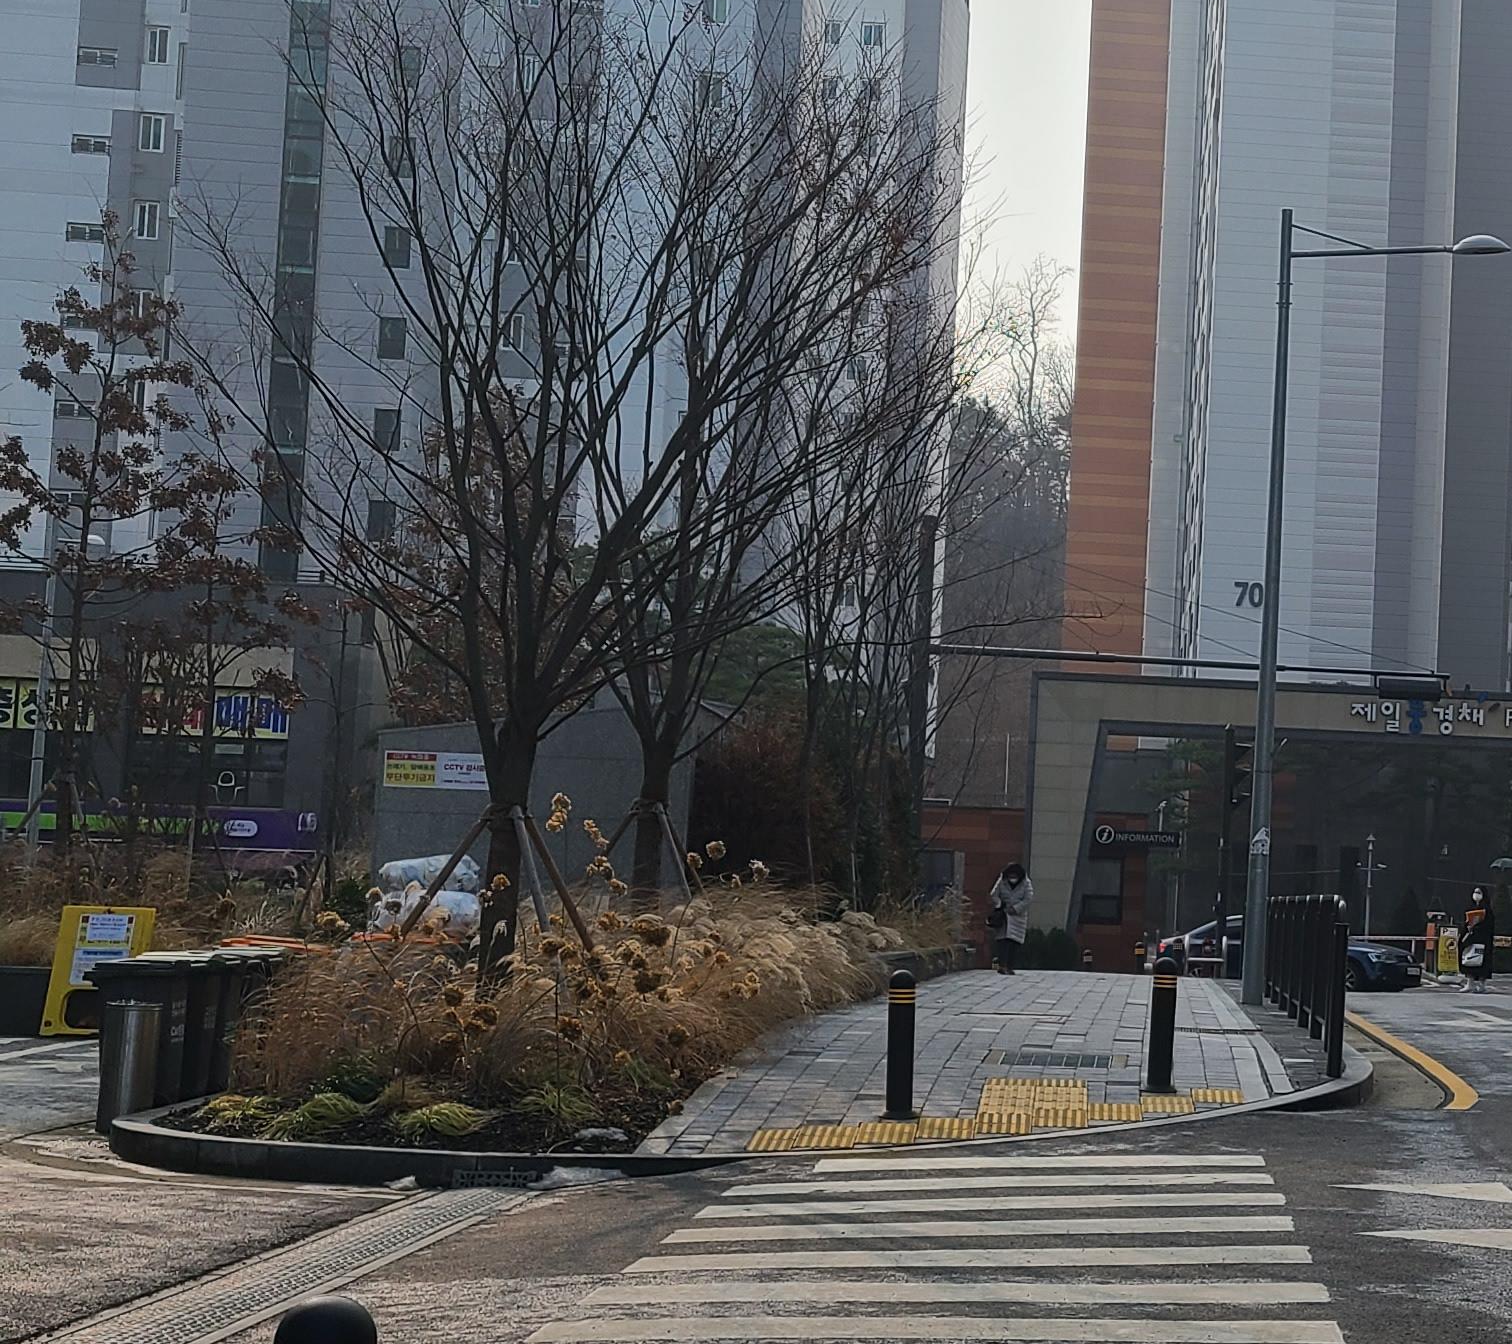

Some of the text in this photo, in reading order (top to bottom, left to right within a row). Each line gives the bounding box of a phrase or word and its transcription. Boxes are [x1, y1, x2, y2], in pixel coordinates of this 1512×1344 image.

[1234, 581, 1264, 608] 70
[1351, 698, 1485, 735] 제일풍경채
[444, 763, 464, 771] CCTV
[1116, 833, 1175, 843] INFORMATION
